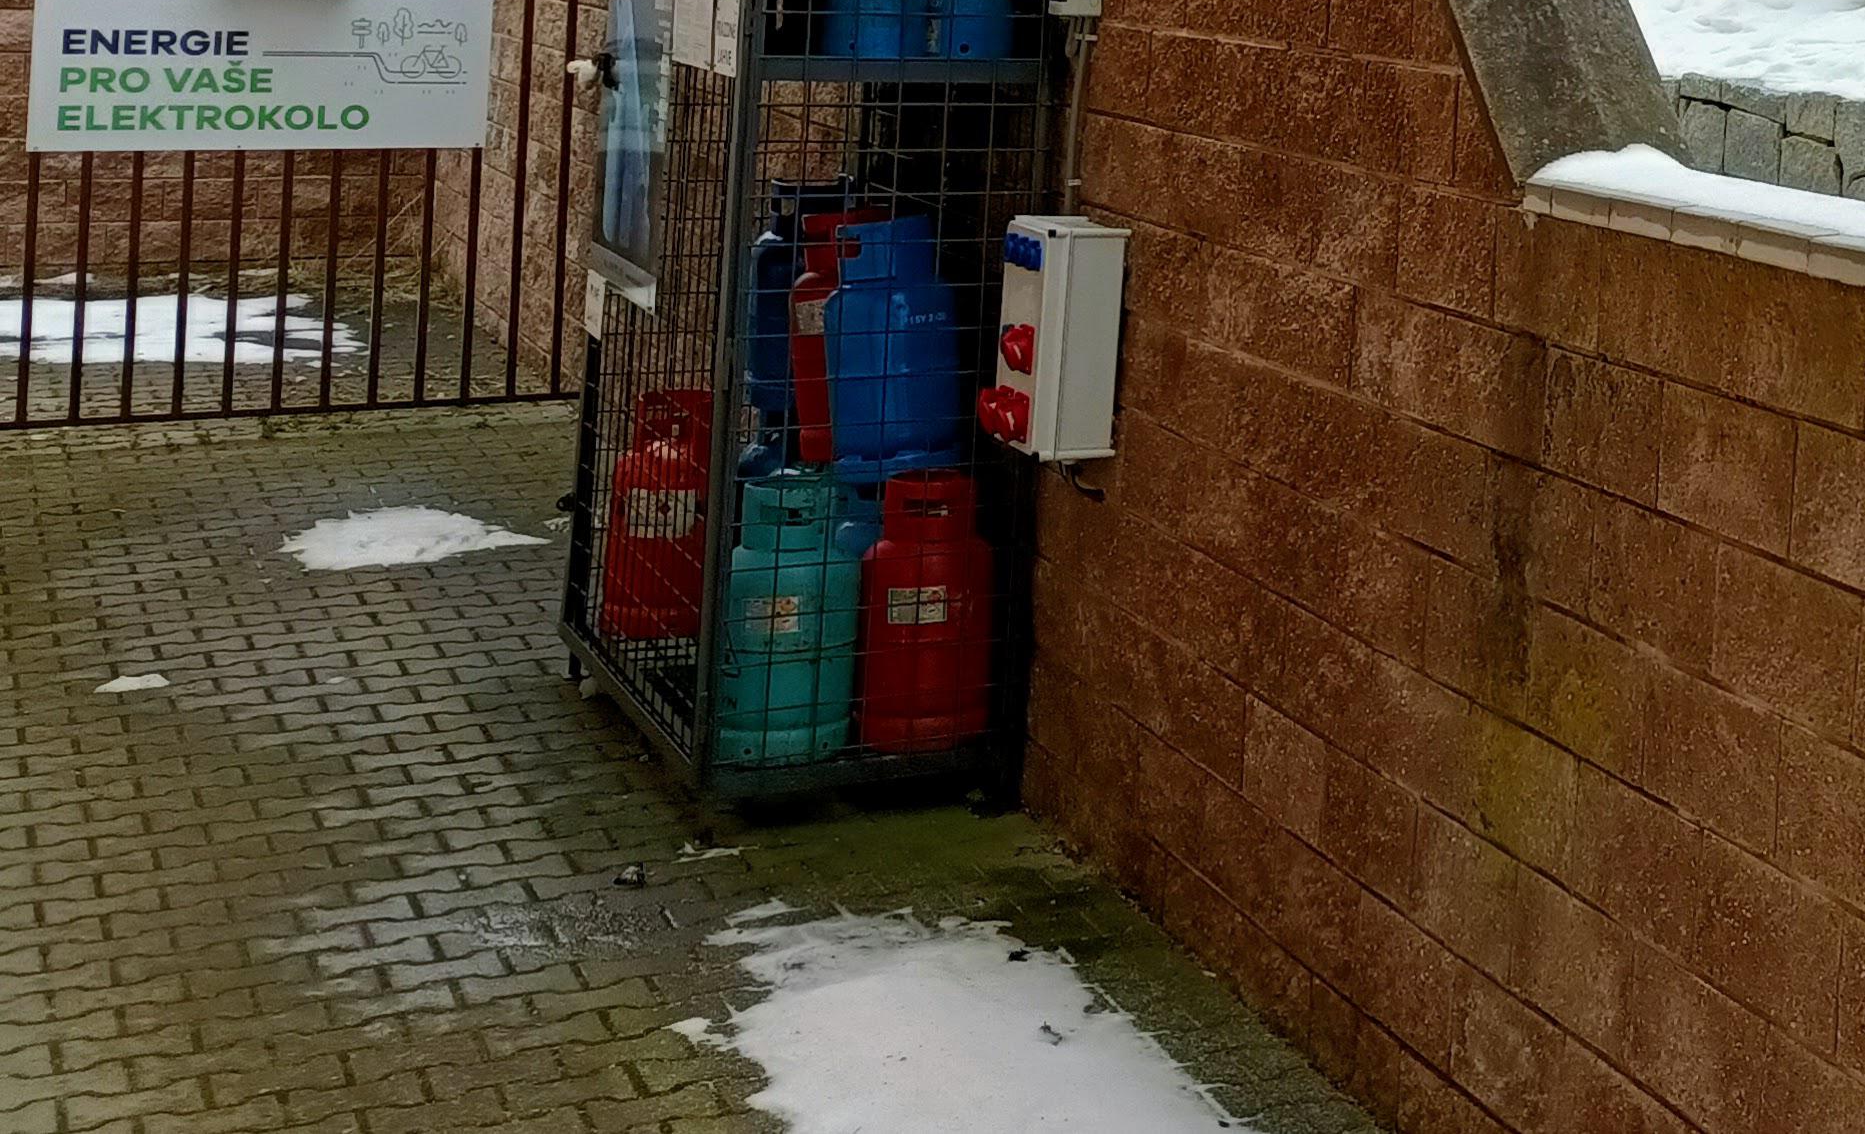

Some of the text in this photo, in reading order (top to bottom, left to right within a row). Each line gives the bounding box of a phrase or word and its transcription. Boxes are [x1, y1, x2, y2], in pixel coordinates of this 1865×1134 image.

[61, 29, 250, 56] ENERGIE
[59, 59, 274, 94] PRO VAŠE
[56, 104, 370, 132] ELEKTROKOLO
